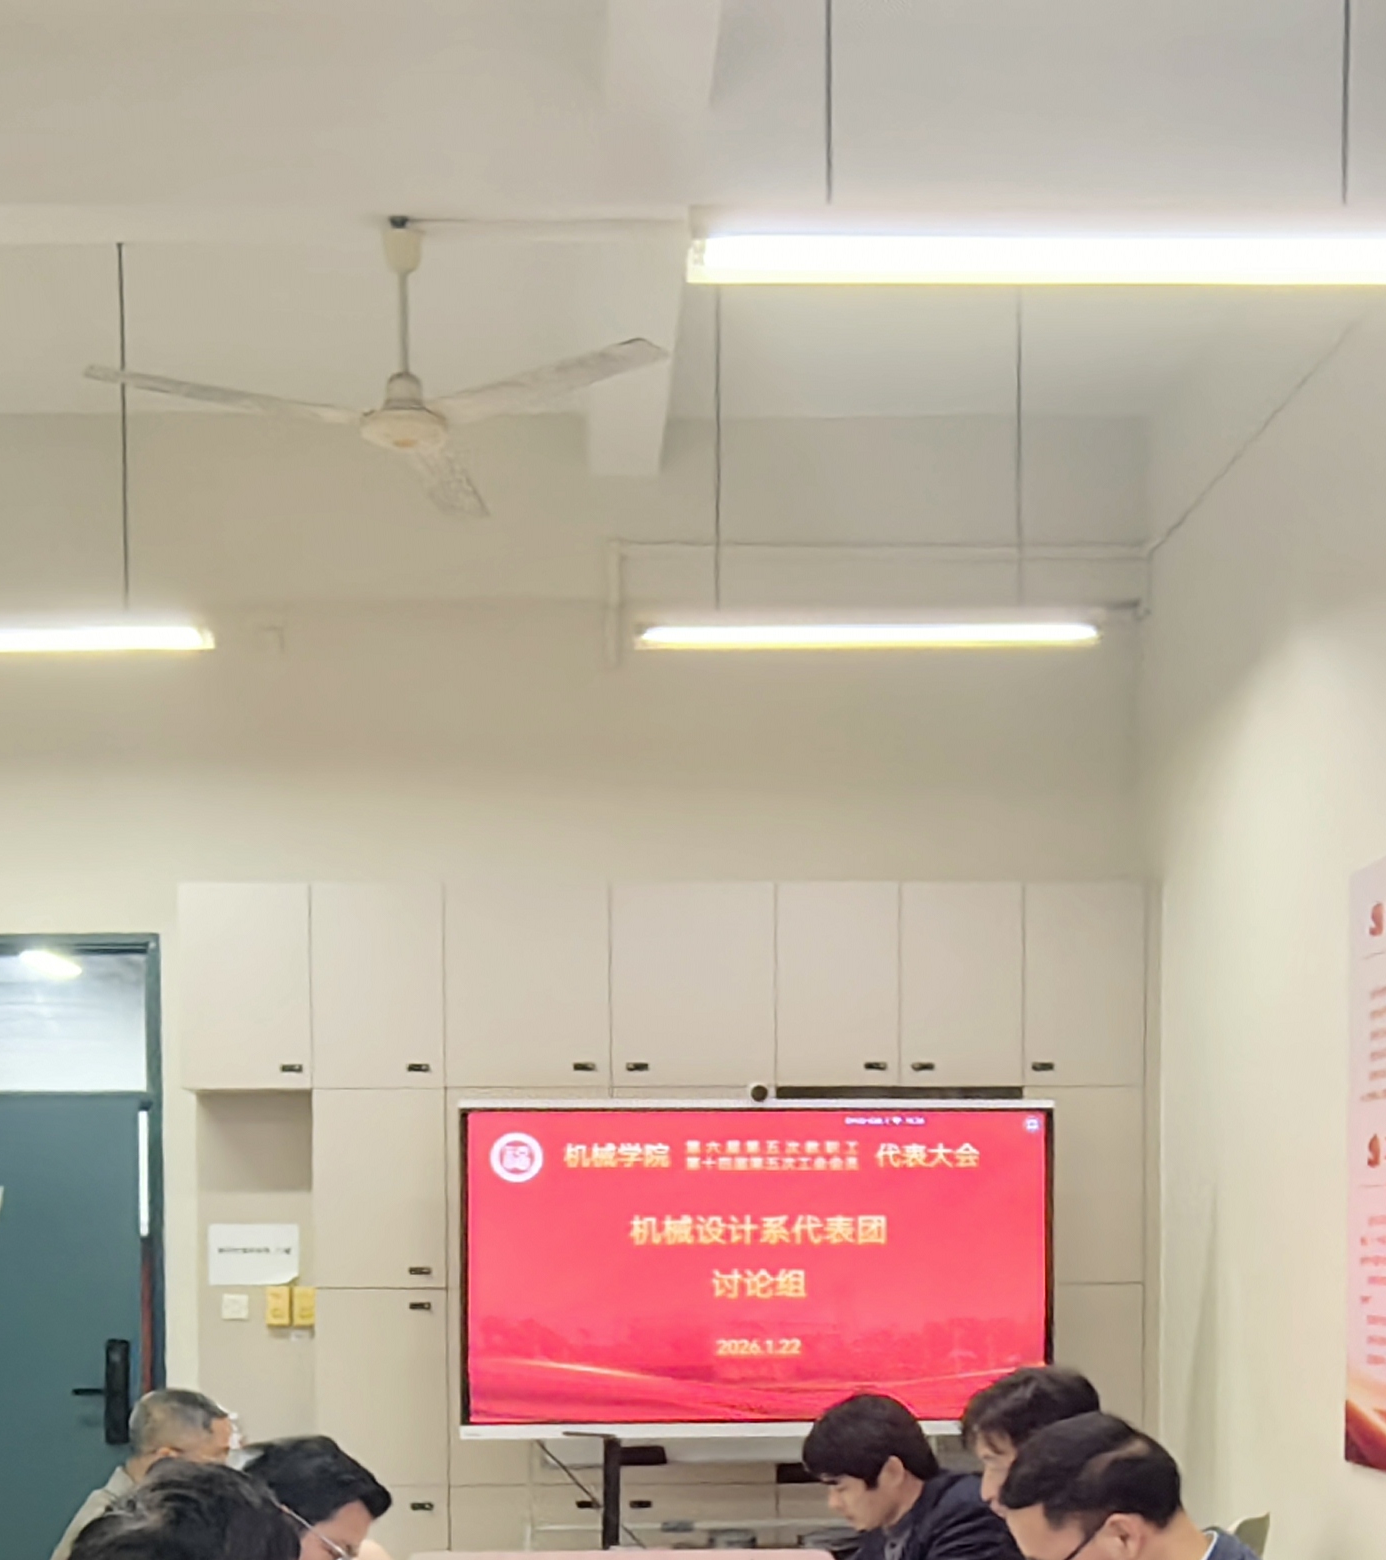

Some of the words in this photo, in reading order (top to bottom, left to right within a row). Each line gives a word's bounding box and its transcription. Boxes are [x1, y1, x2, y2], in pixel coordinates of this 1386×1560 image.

[564, 1142, 670, 1168] 机械学院
[875, 1142, 980, 1168] 代表大会
[629, 1214, 887, 1246] 机械设计系代表团
[712, 1268, 807, 1299] 讨论组
[715, 1337, 802, 1356] 2026.1.22
